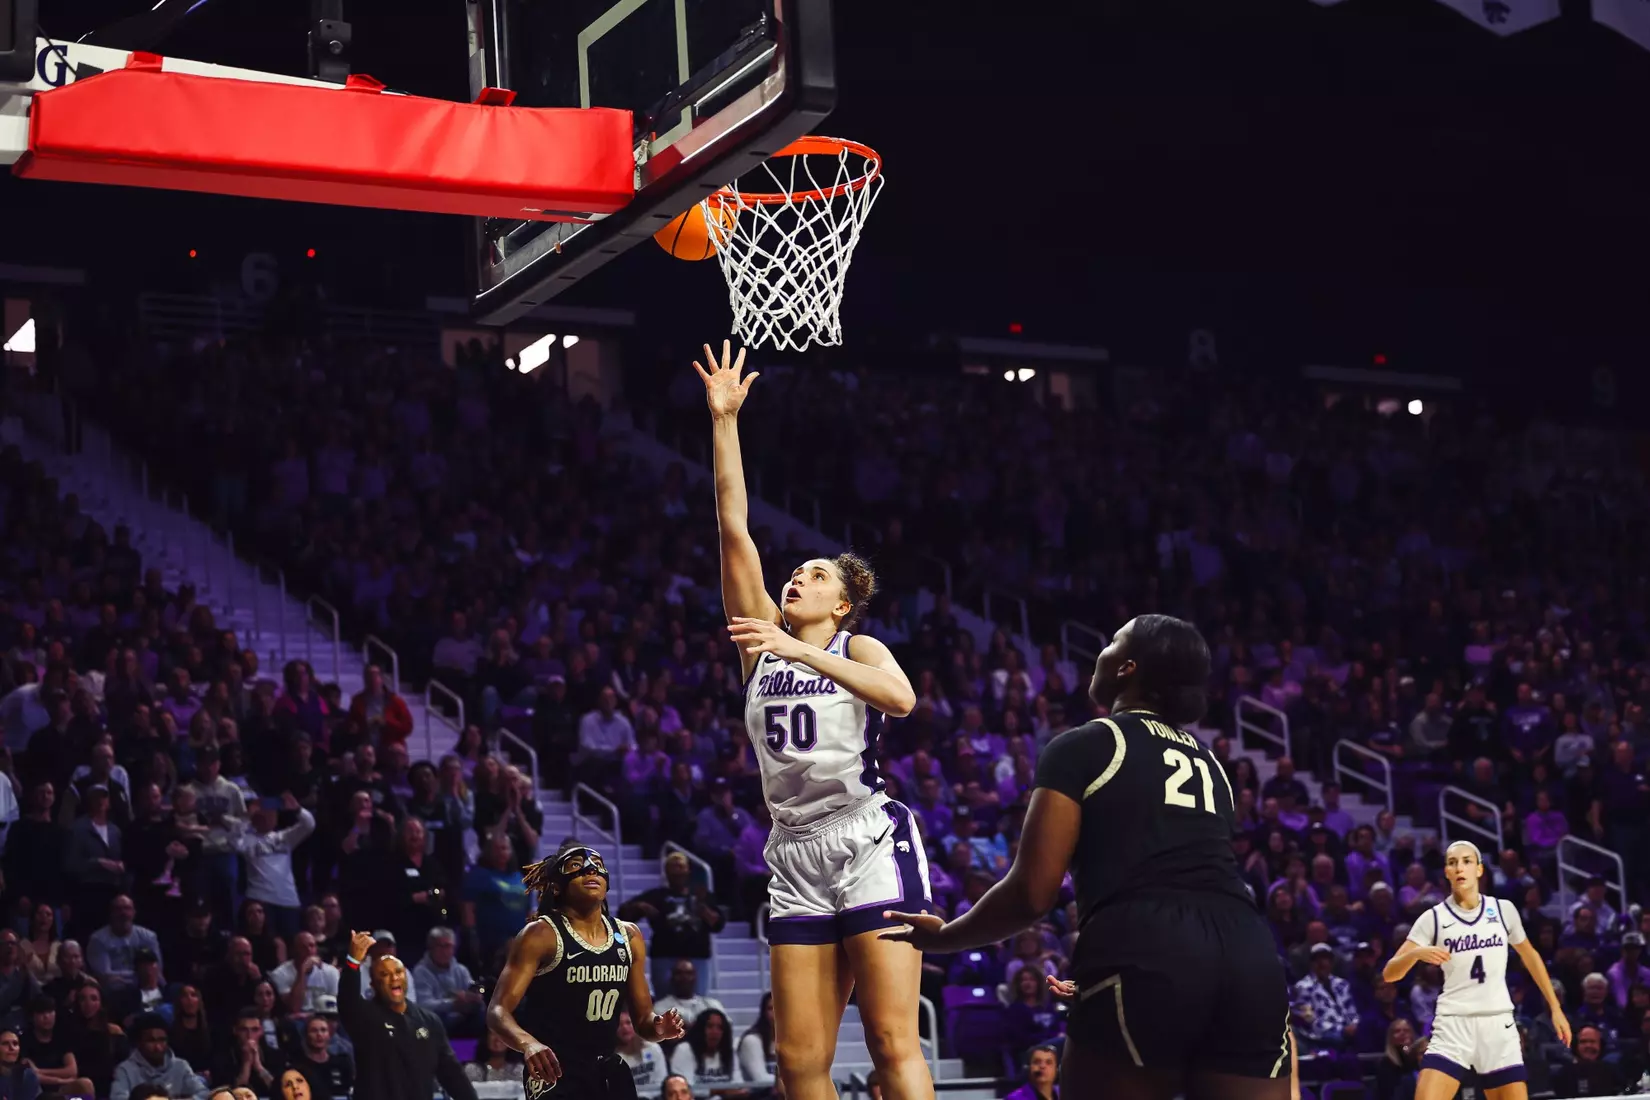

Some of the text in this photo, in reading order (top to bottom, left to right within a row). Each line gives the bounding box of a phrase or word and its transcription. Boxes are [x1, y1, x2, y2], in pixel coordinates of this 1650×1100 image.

[241, 252, 278, 300] 6
[757, 670, 838, 697] Wildcats
[764, 703, 818, 753] 50
[1162, 747, 1216, 814] 21
[1443, 934, 1503, 954] Wildcats
[566, 964, 629, 984] COLORADO
[1470, 955, 1486, 984] 4
[585, 988, 620, 1022] 00
